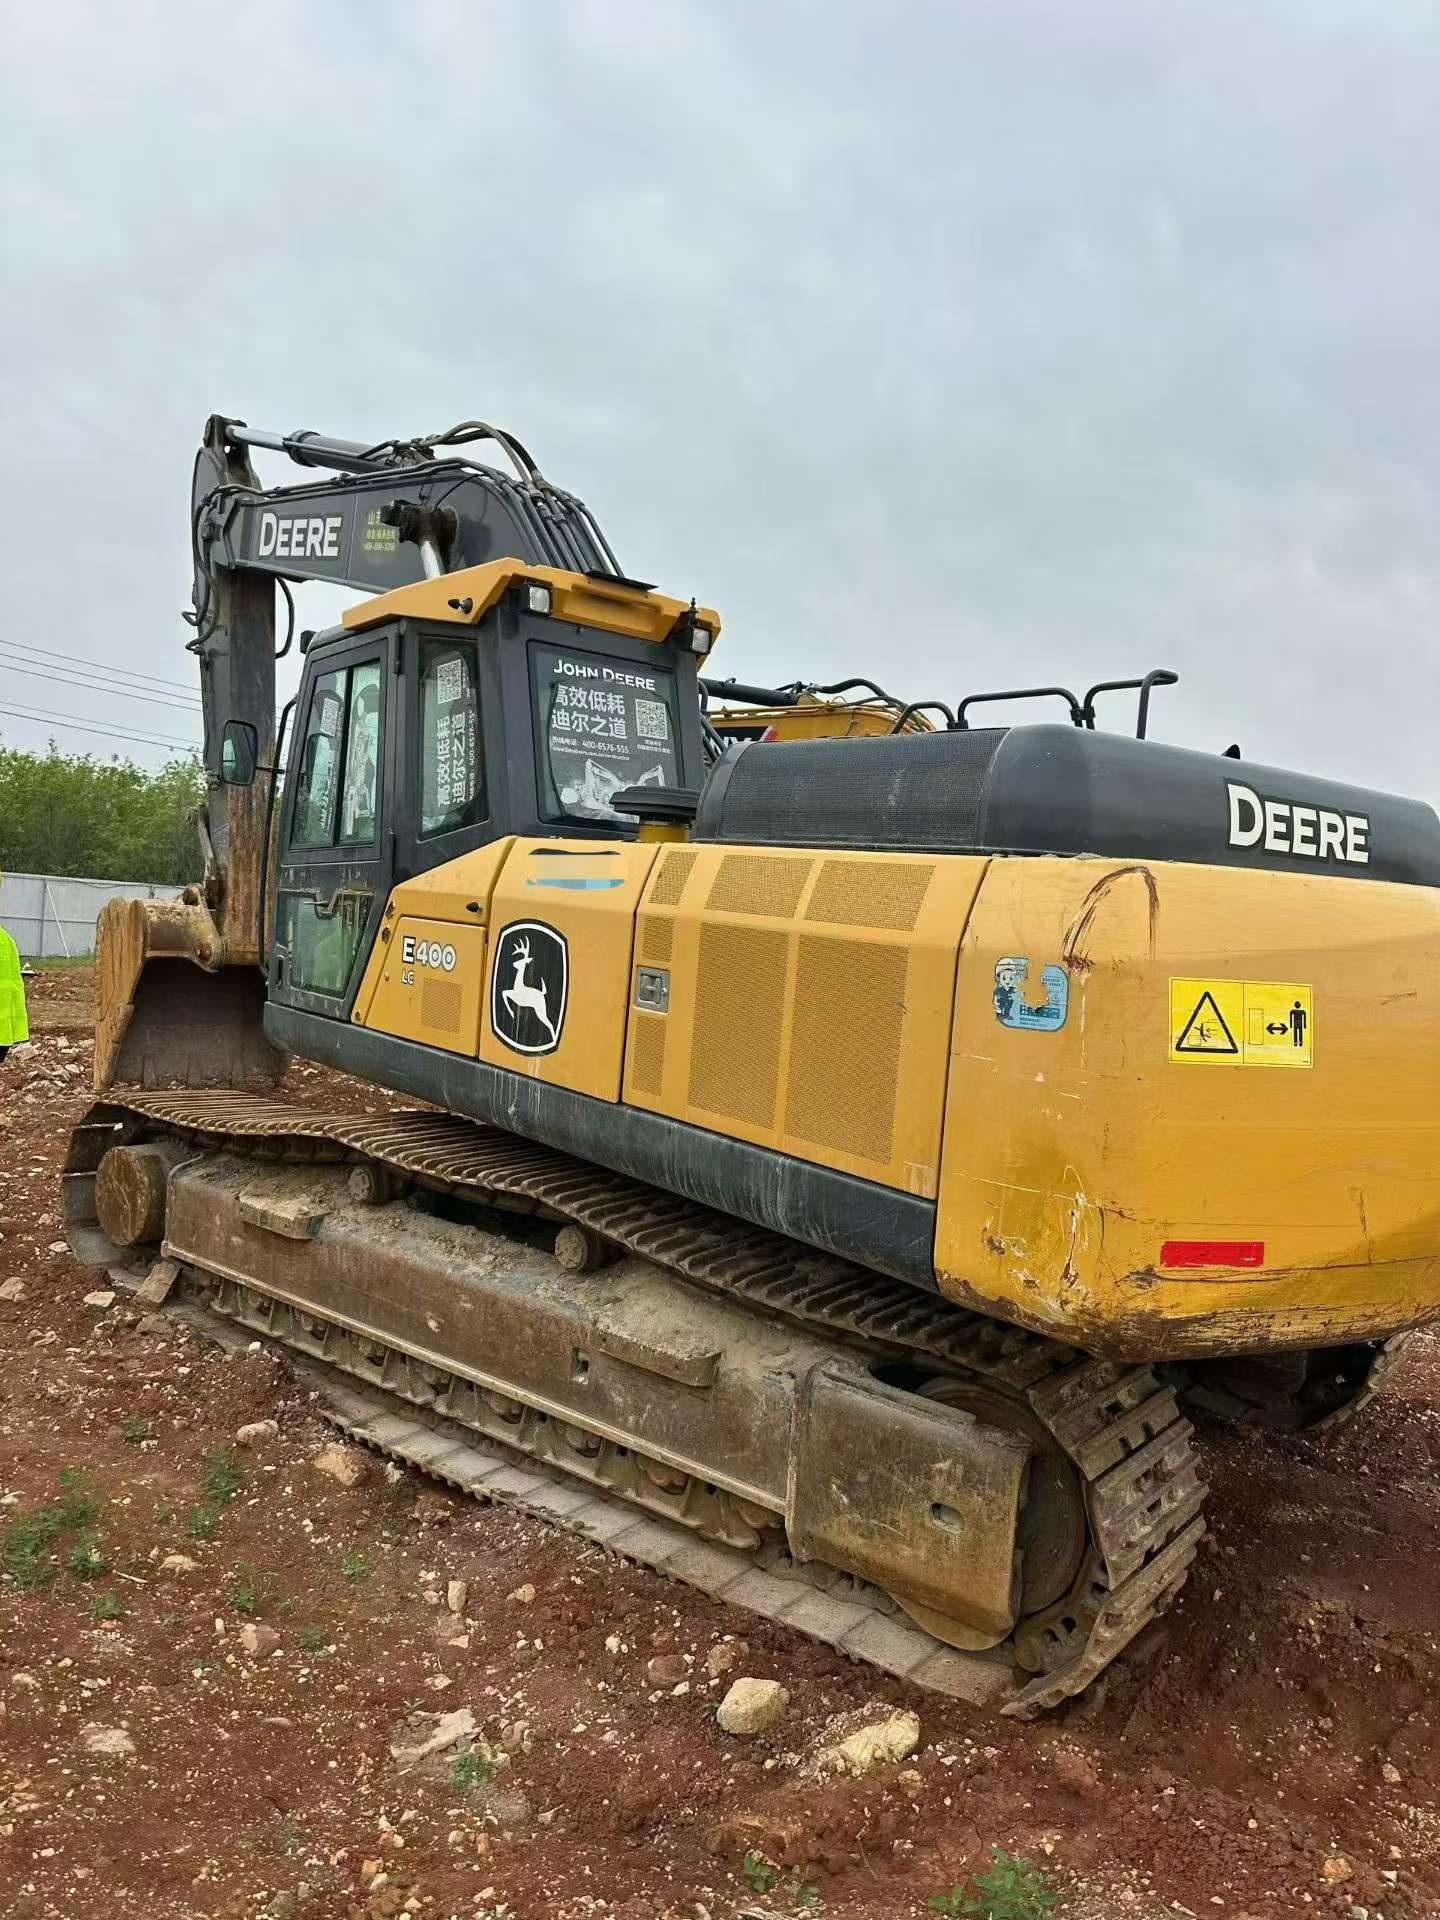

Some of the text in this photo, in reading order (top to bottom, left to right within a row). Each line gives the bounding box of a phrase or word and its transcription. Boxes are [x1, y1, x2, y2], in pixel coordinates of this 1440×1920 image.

[259, 512, 342, 557] DEERE
[553, 659, 656, 692] JOHN DEERE
[556, 684, 626, 715] 高效低耗
[551, 708, 628, 740] 迪尔之道
[437, 715, 451, 808] 高效低耗
[452, 711, 466, 804] 迪尔之道
[1227, 783, 1370, 864] DEERE
[402, 936, 457, 972] E400
[402, 969, 415, 985] LC
